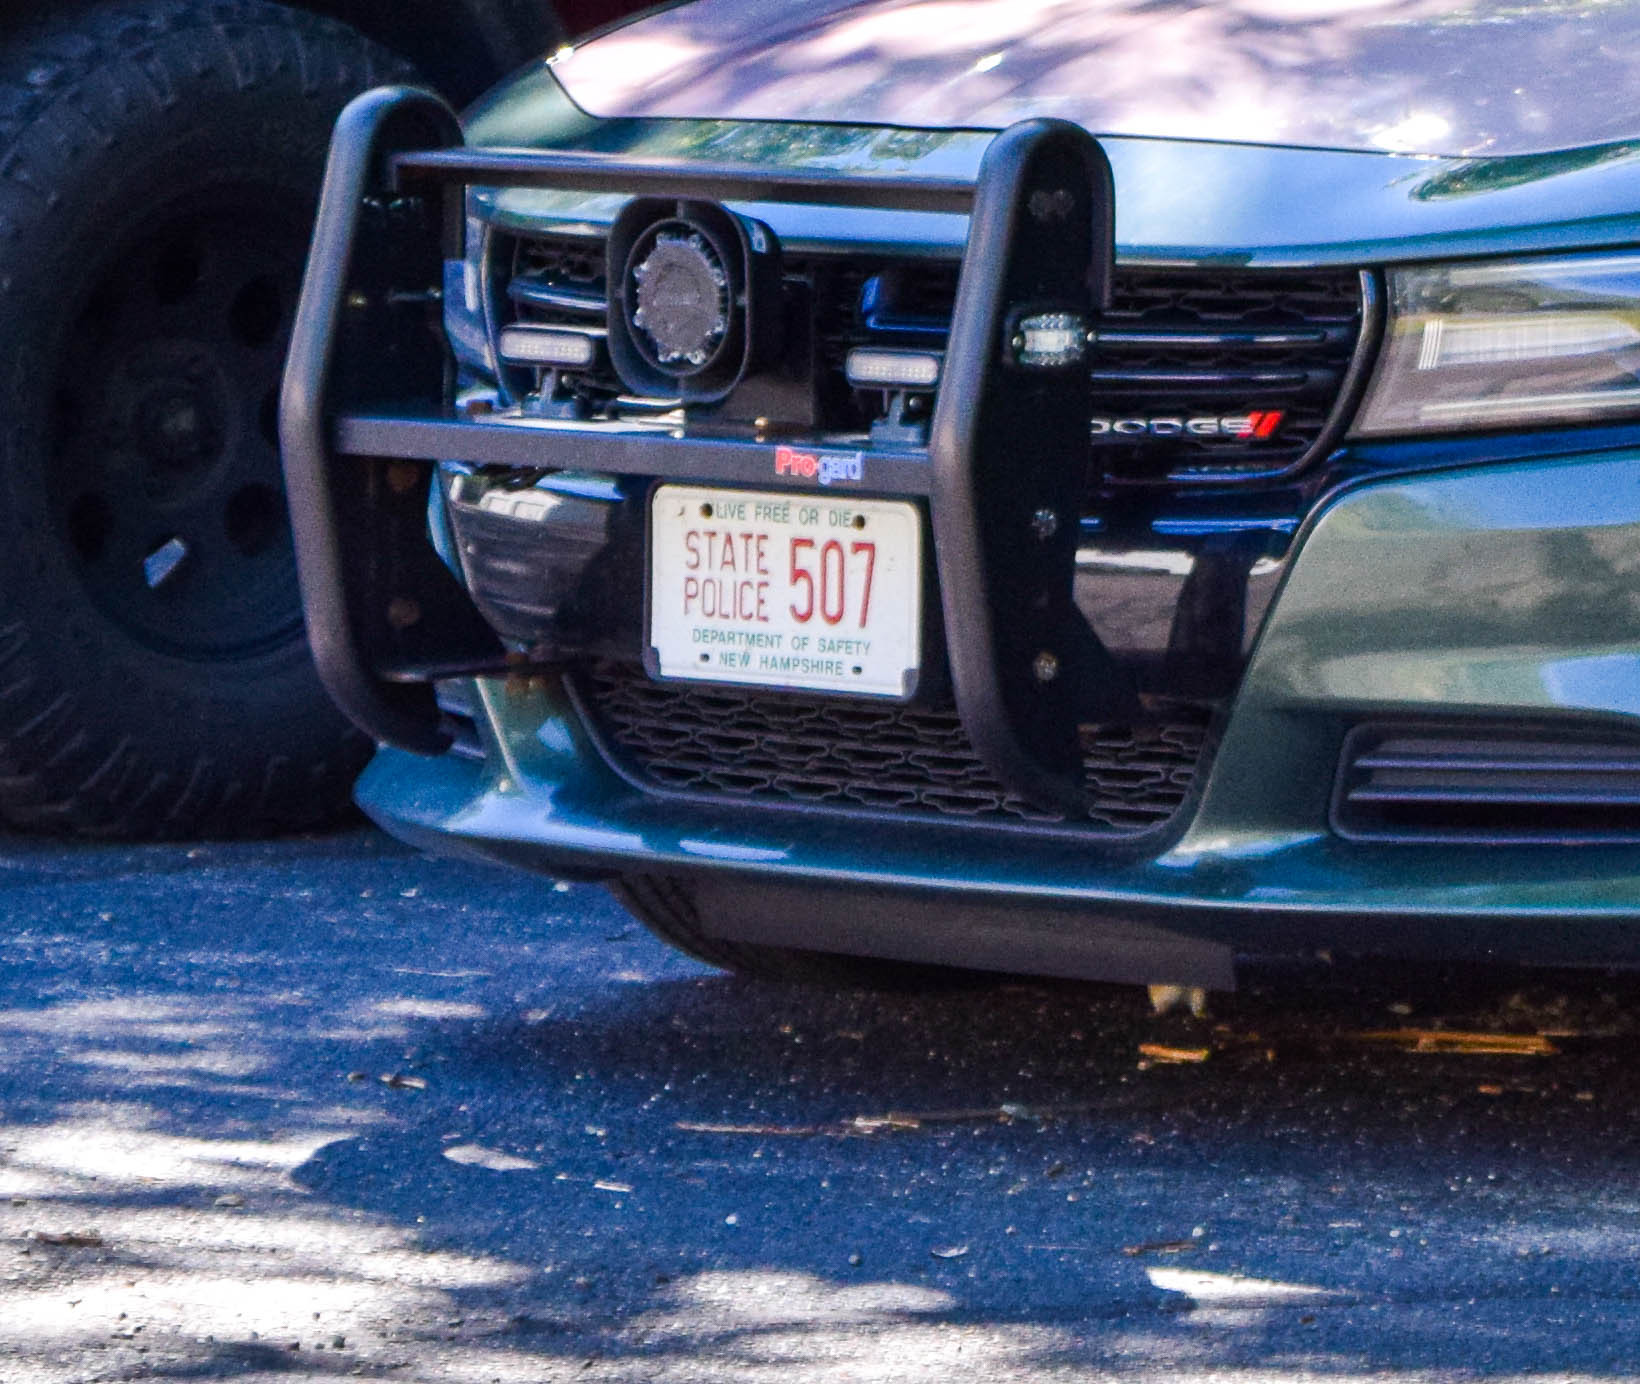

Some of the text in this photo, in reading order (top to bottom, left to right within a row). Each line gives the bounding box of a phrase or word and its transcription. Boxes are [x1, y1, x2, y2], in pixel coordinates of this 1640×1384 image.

[715, 502, 852, 528] LIVE FREE OR DIE
[684, 530, 770, 575] STATE
[683, 577, 770, 623] POLICE
[788, 537, 876, 629] 507
[692, 628, 872, 657] DEPARTMENT OF SAFETY
[719, 651, 844, 676] NEW HAMPSHIRE
